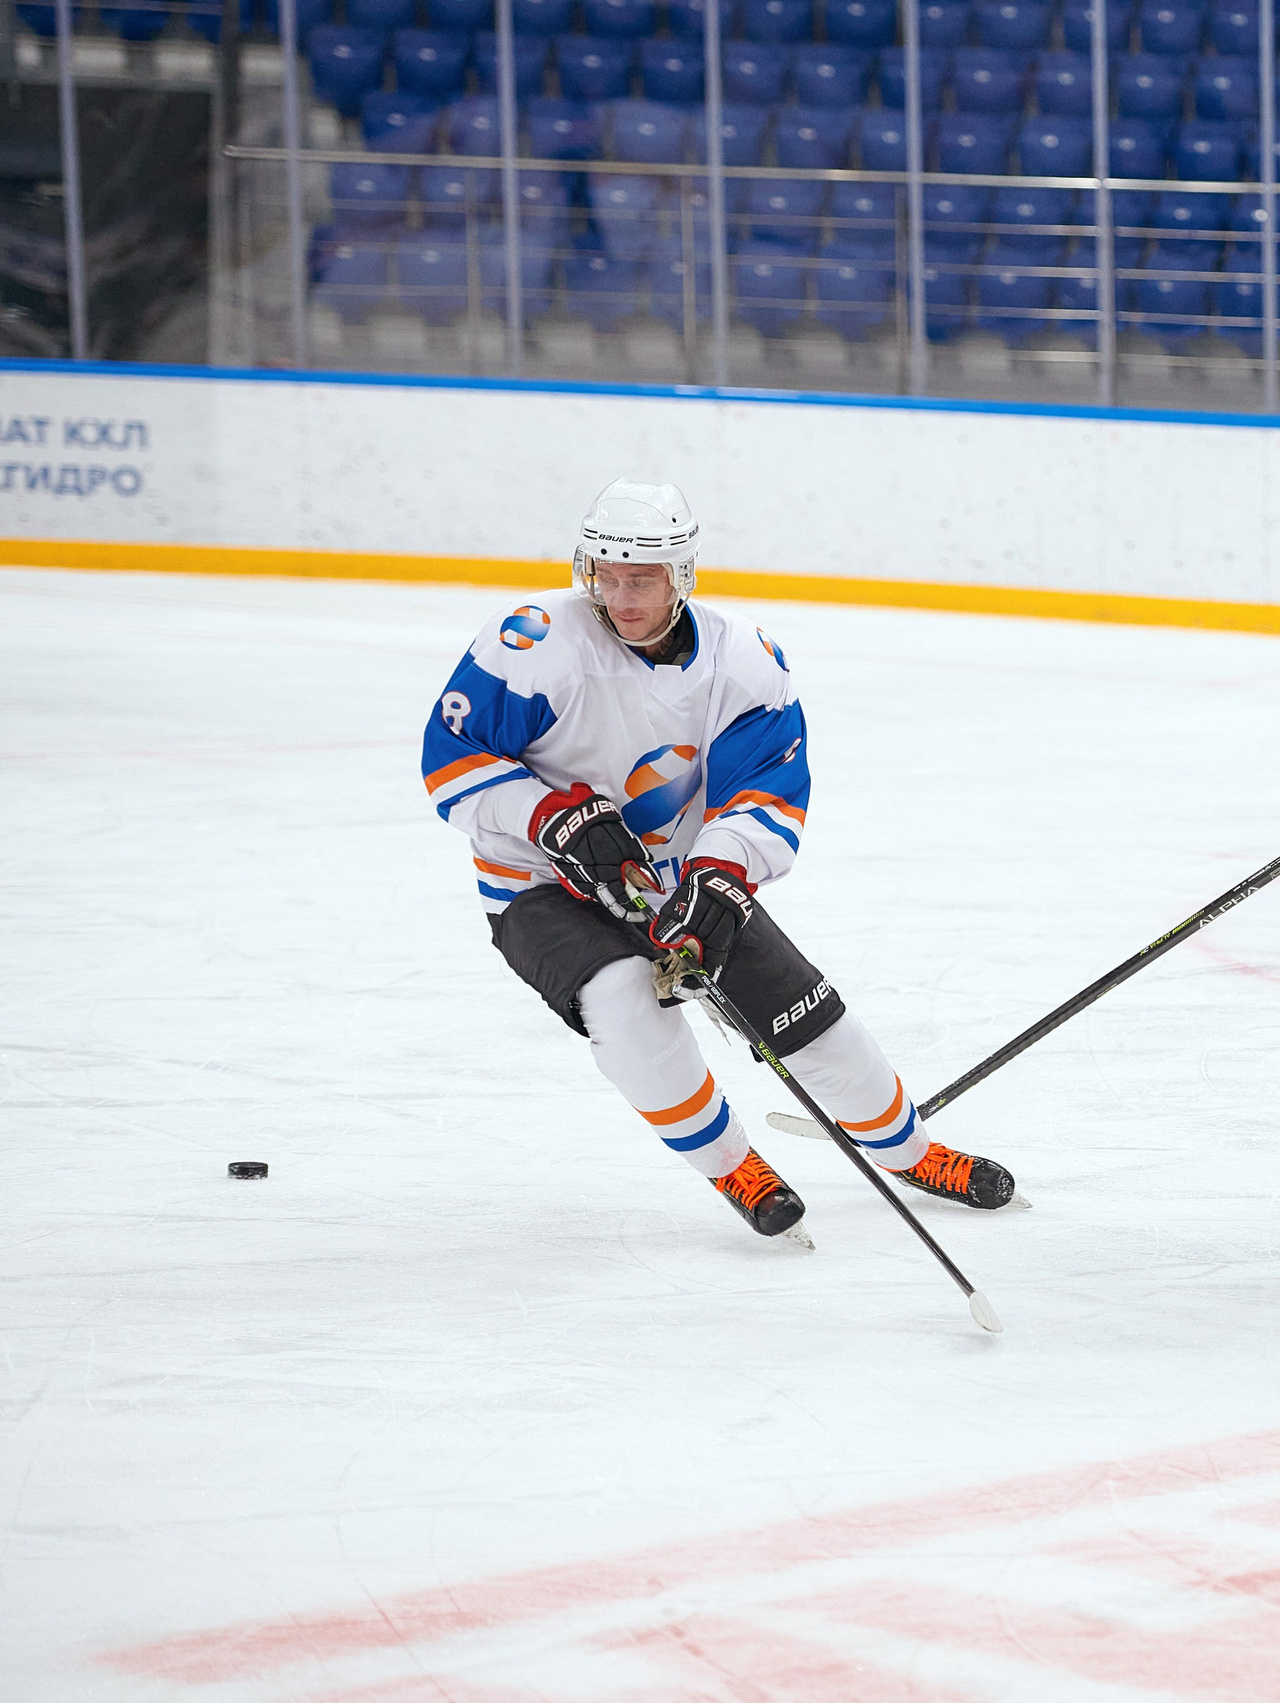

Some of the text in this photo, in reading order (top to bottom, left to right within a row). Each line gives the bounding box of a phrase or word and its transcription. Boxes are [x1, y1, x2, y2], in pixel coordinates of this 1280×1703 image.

[0, 418, 49, 443] АТ
[0, 464, 143, 497] ГИДРО
[598, 533, 634, 544] BAUER
[1199, 885, 1259, 929] ALPHA
